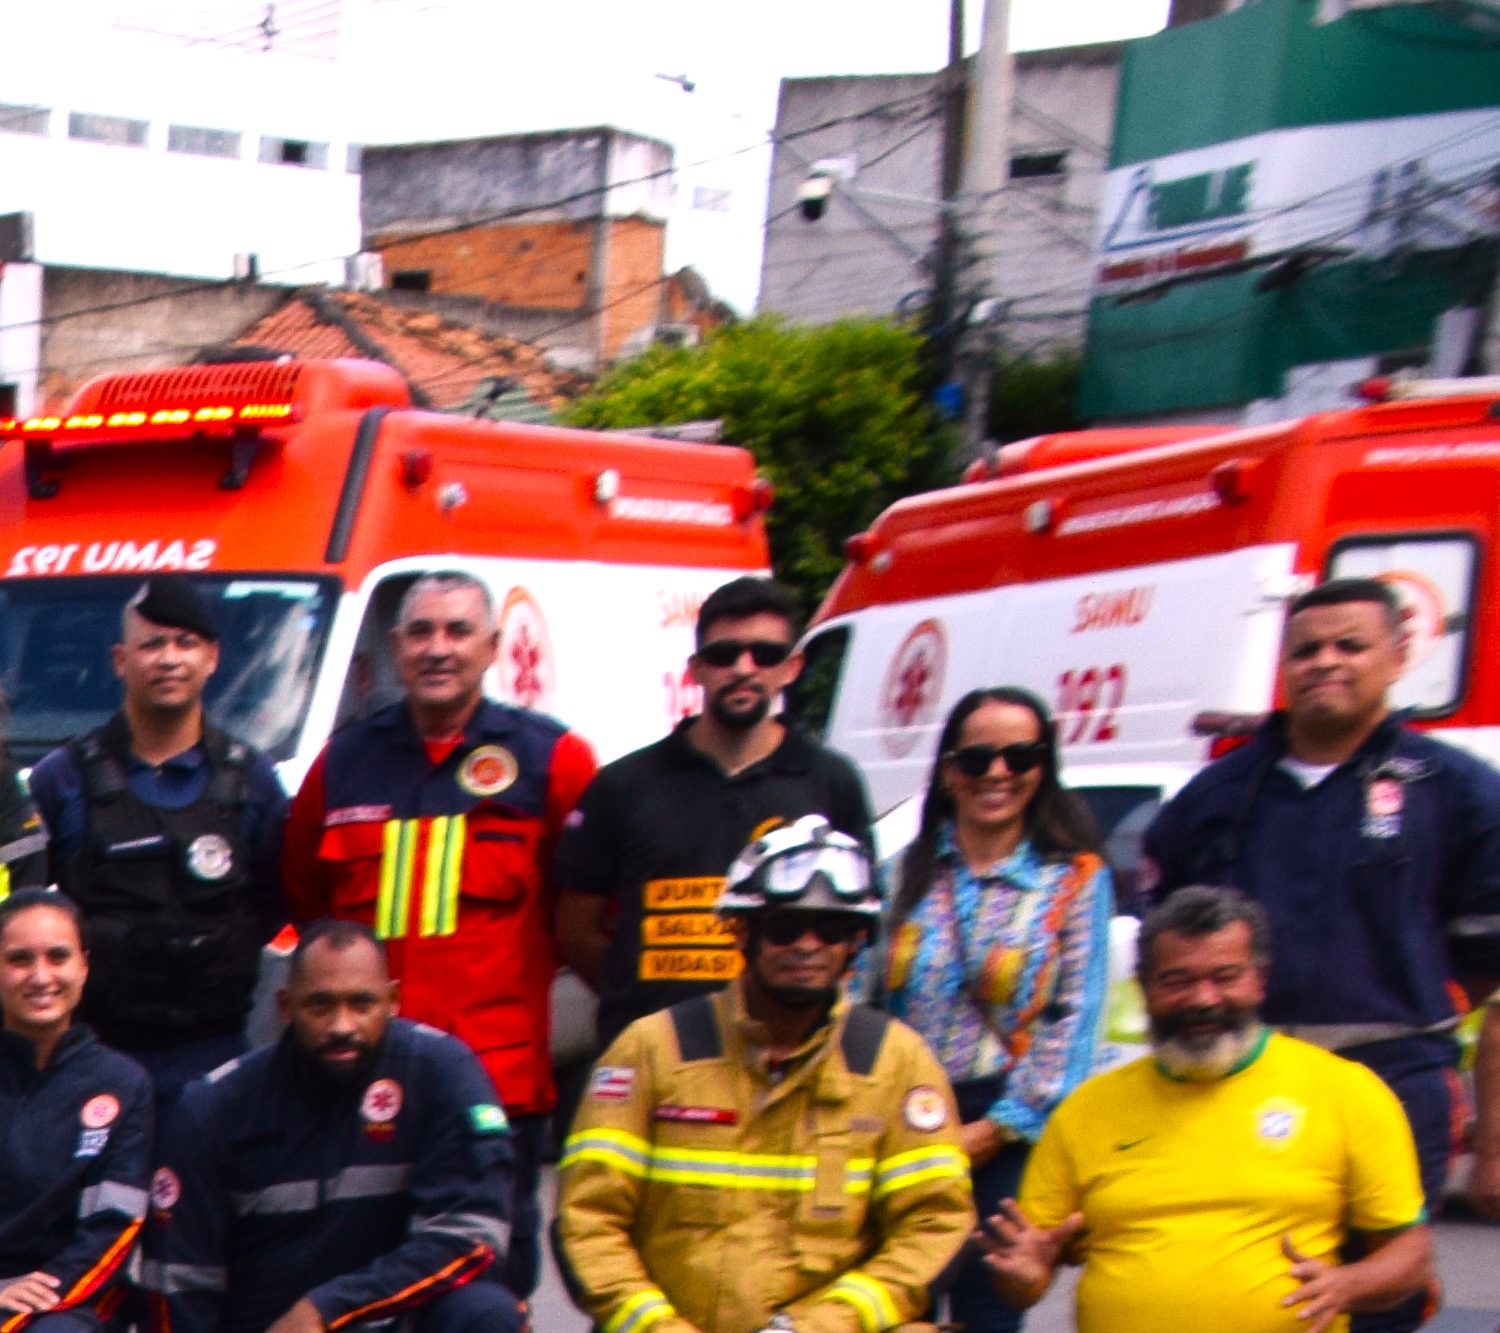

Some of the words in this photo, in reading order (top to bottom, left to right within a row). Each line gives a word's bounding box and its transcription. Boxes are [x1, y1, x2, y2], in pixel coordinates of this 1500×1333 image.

[1070, 584, 1157, 636] SAMU
[1056, 662, 1129, 745] 192
[656, 882, 721, 902] JUNT
